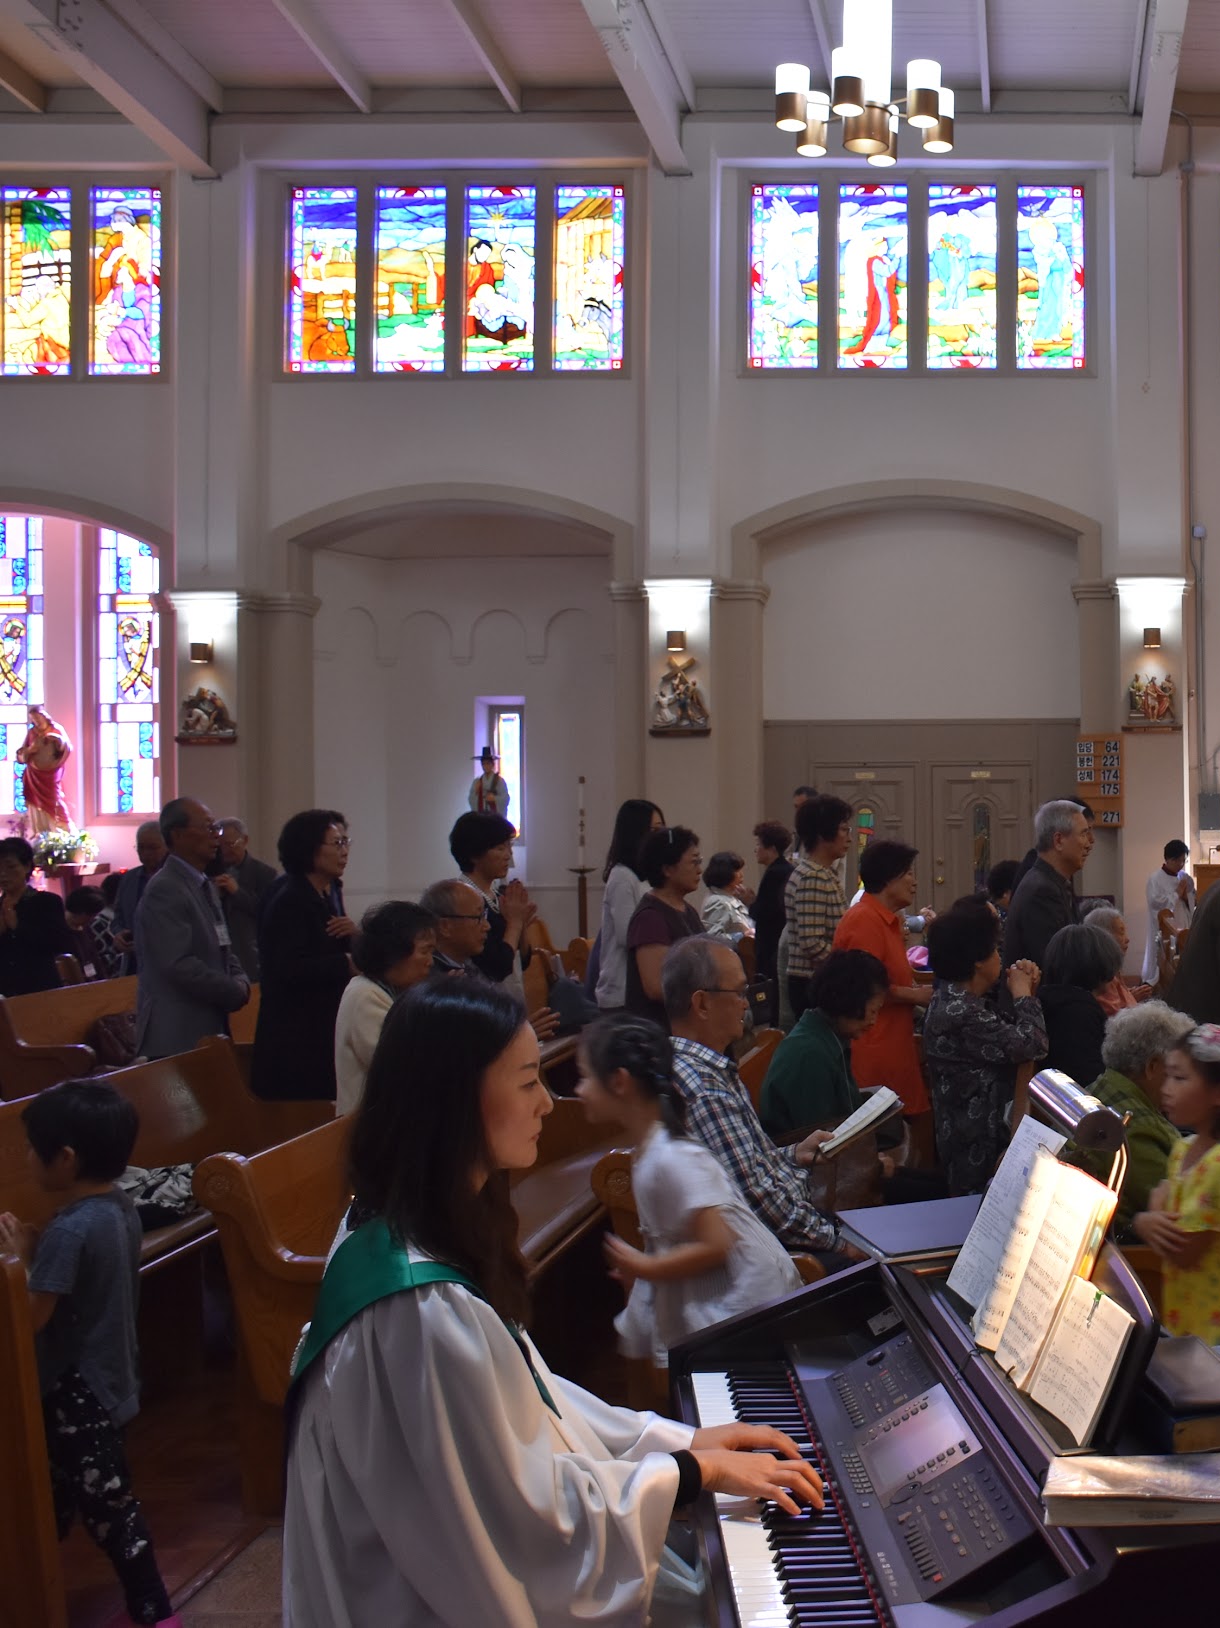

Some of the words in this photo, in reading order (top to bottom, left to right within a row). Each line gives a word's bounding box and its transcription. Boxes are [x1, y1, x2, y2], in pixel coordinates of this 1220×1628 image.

[1078, 743, 1093, 753] 입당
[1105, 742, 1118, 752] 64
[1078, 756, 1093, 767] 봉헌
[1103, 756, 1120, 766] 221
[1078, 770, 1093, 781] 성체
[1101, 770, 1119, 780] 174
[1101, 784, 1119, 794] 175
[1103, 812, 1120, 822] 271
